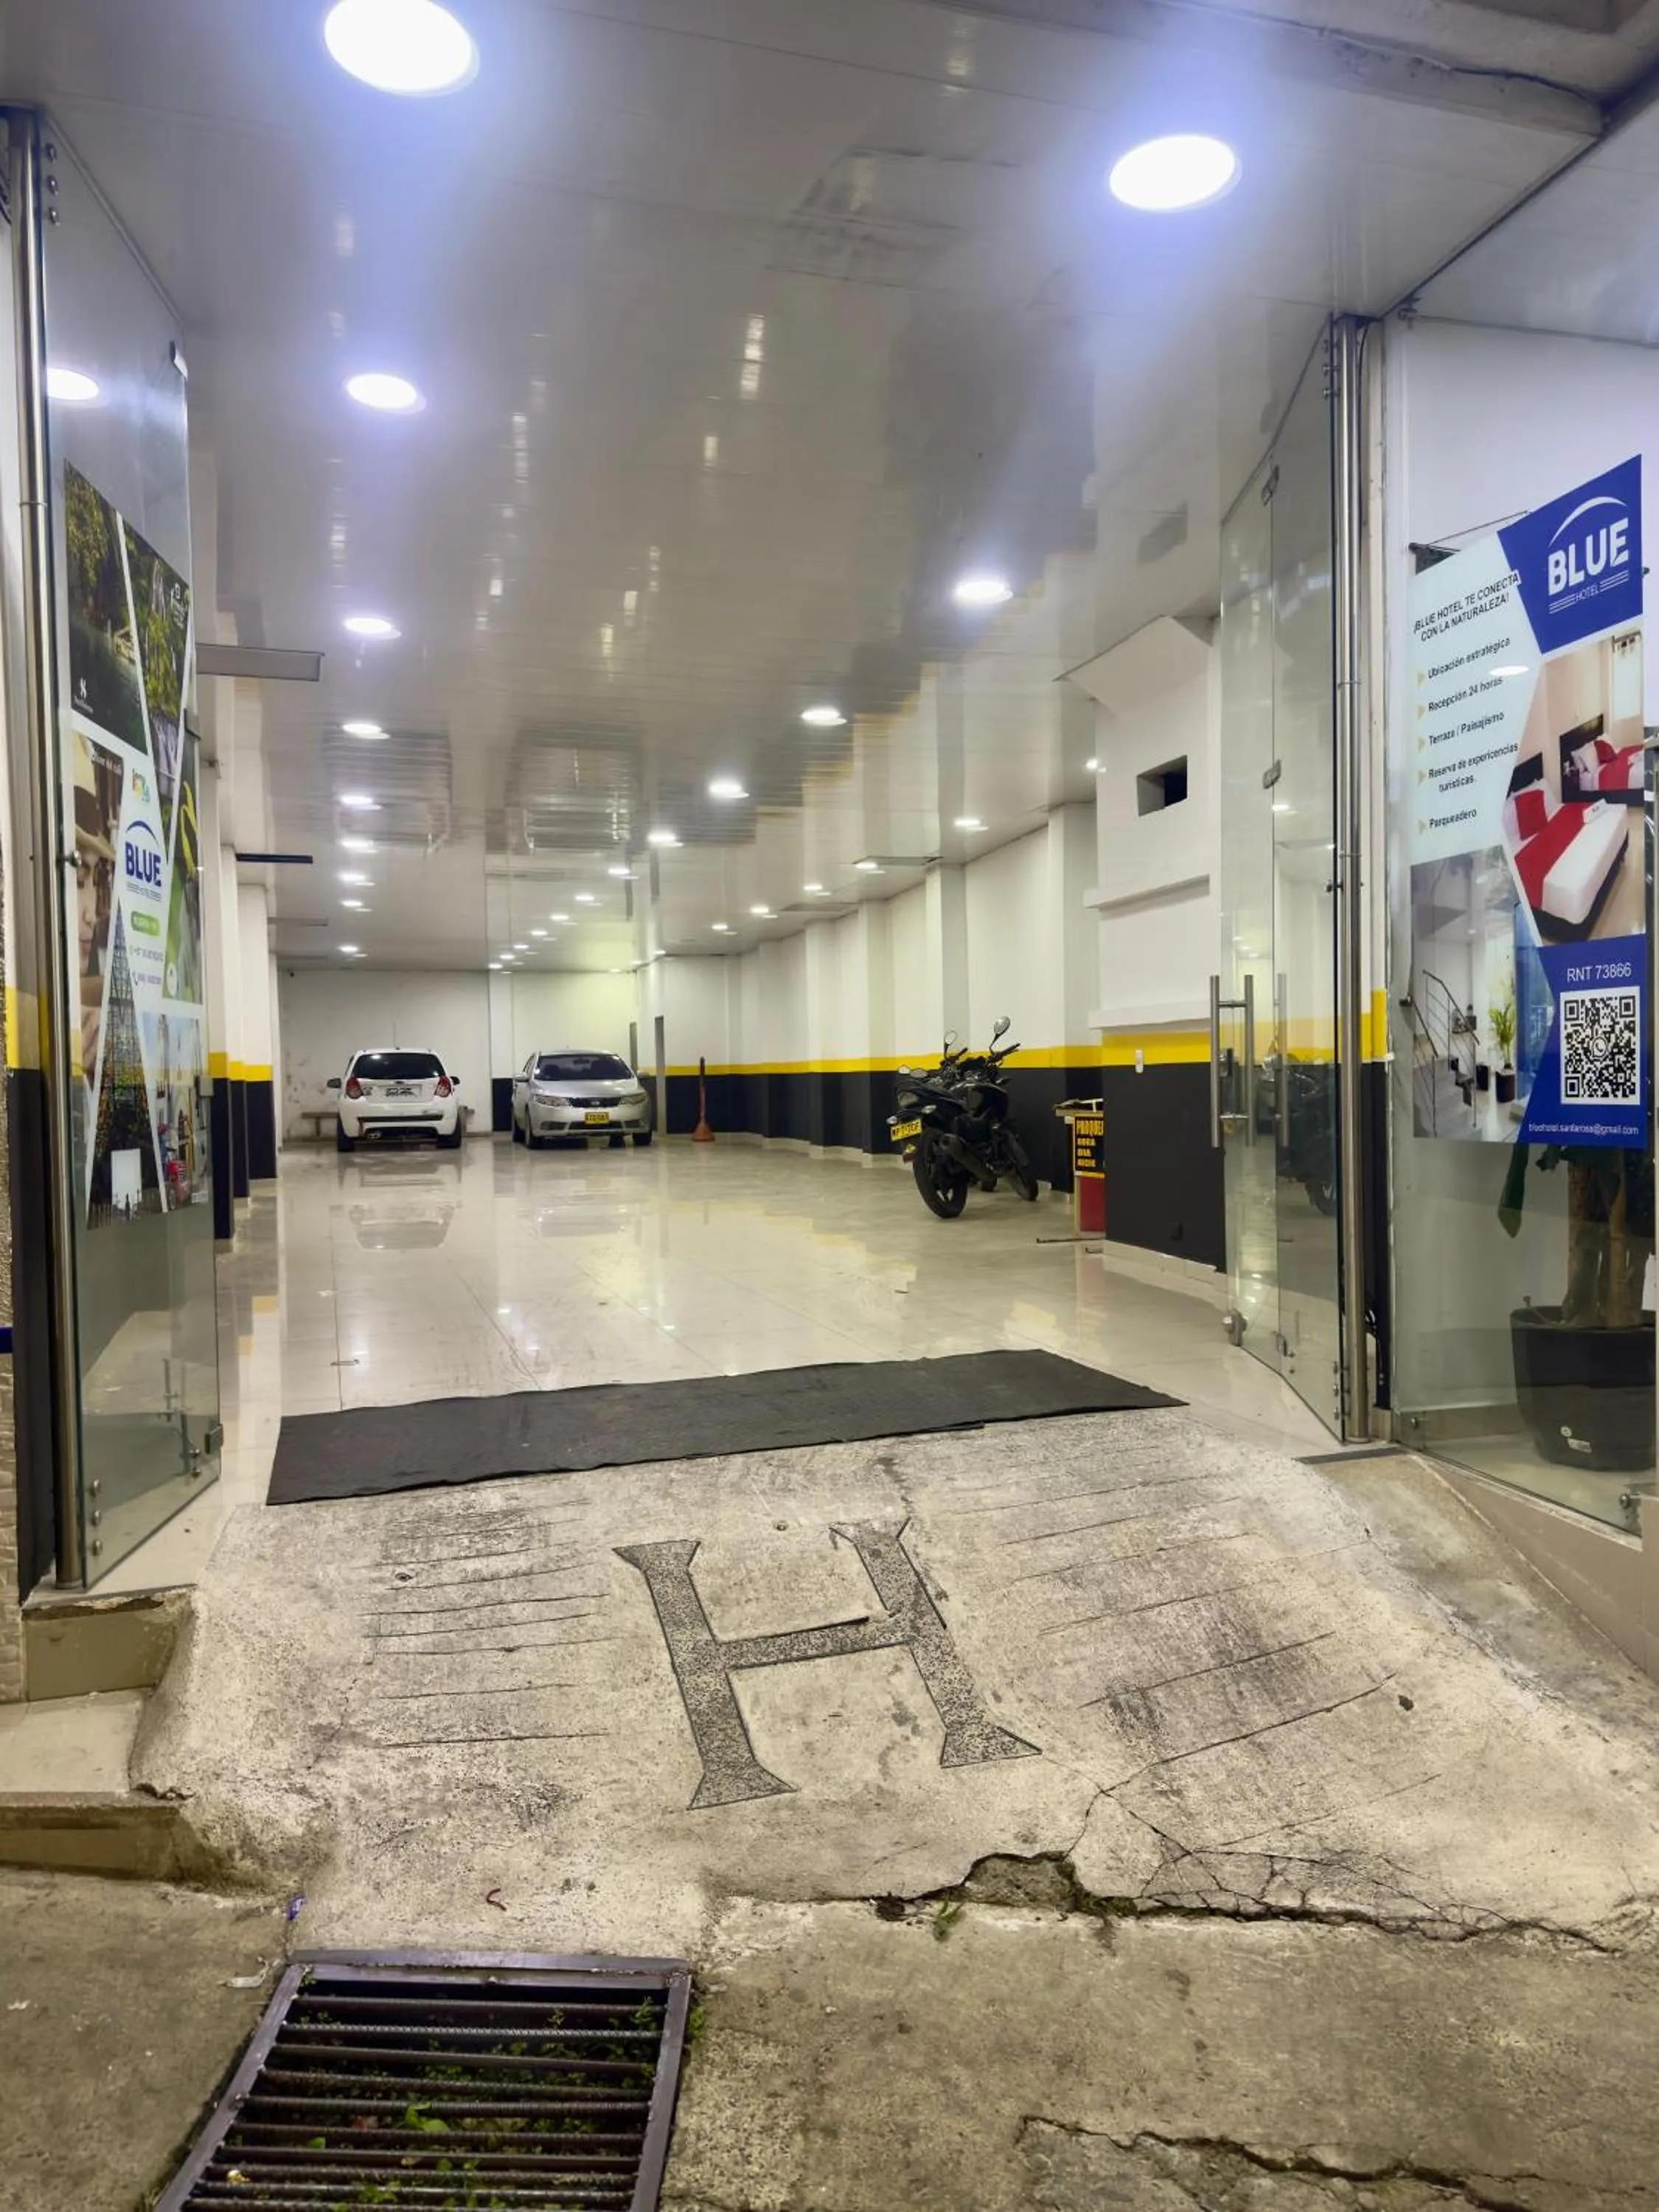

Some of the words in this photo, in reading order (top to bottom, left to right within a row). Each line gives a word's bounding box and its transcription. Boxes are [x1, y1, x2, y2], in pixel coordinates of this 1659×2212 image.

[1548, 518, 1629, 596] BLUE
[1438, 601, 1463, 620] HOTEL
[1465, 593, 1475, 606] TE
[1477, 573, 1519, 601] CONECTA
[1421, 630, 1438, 641] CON
[1439, 621, 1450, 633] LA
[1469, 684, 1478, 697] 24
[1480, 676, 1503, 692] horas
[1428, 728, 1455, 745] Terraza
[1428, 763, 1456, 779] Reserva
[1458, 760, 1467, 771] de
[1468, 742, 1518, 767] experiencias
[1429, 809, 1477, 829] Parqueadero
[125, 841, 161, 887] BLUE
[1567, 967, 1592, 982] RNT
[1595, 962, 1632, 980] 73866
[611, 1517, 1043, 1811] H
